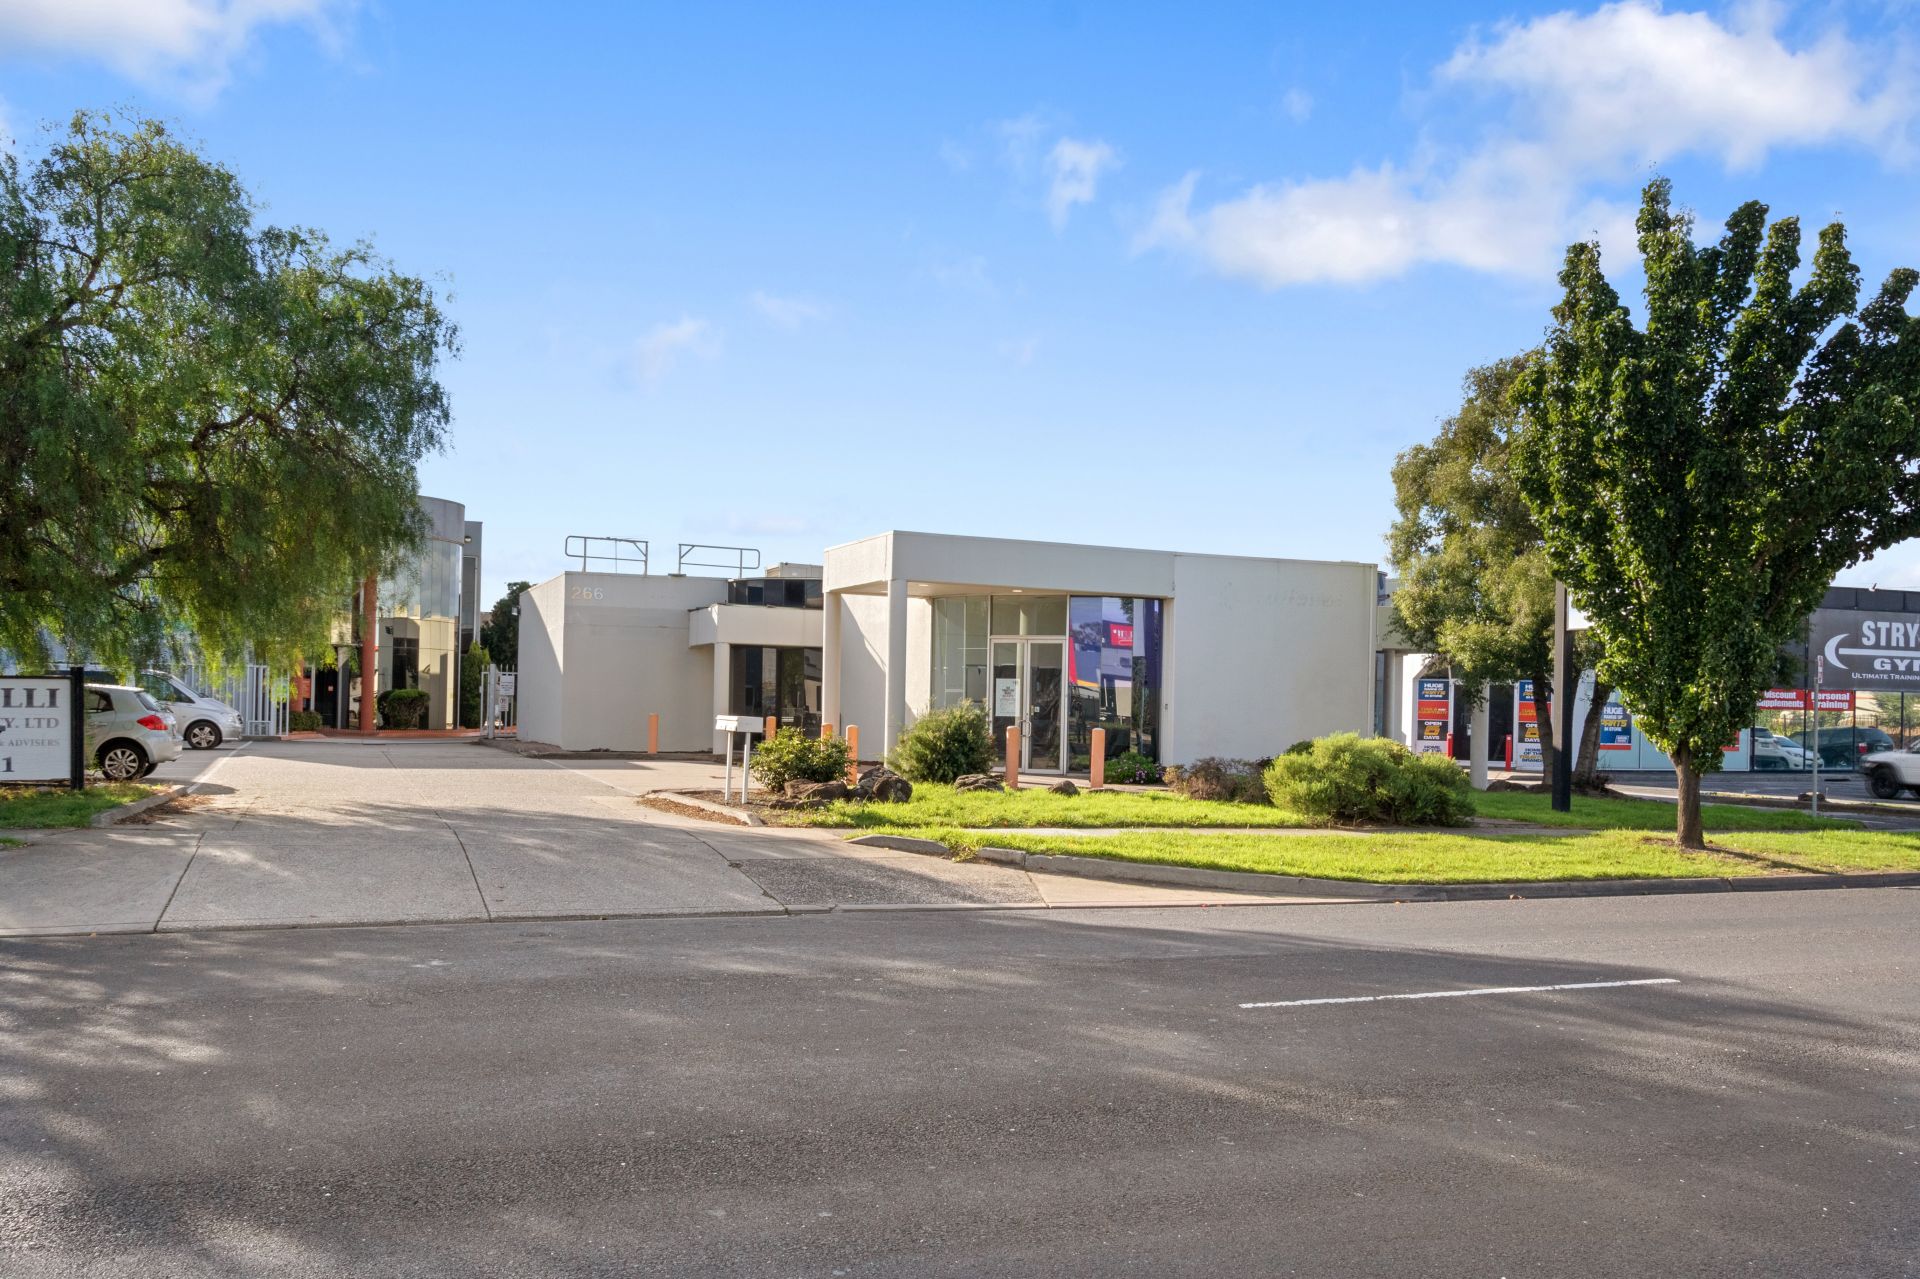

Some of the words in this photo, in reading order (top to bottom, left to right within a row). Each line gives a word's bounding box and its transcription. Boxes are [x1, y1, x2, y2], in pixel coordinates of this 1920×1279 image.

[571, 586, 603, 600] 266
[1603, 706, 1623, 715] HUGE
[24, 717, 60, 729] LTD
[8, 739, 60, 747] ADVISERS
